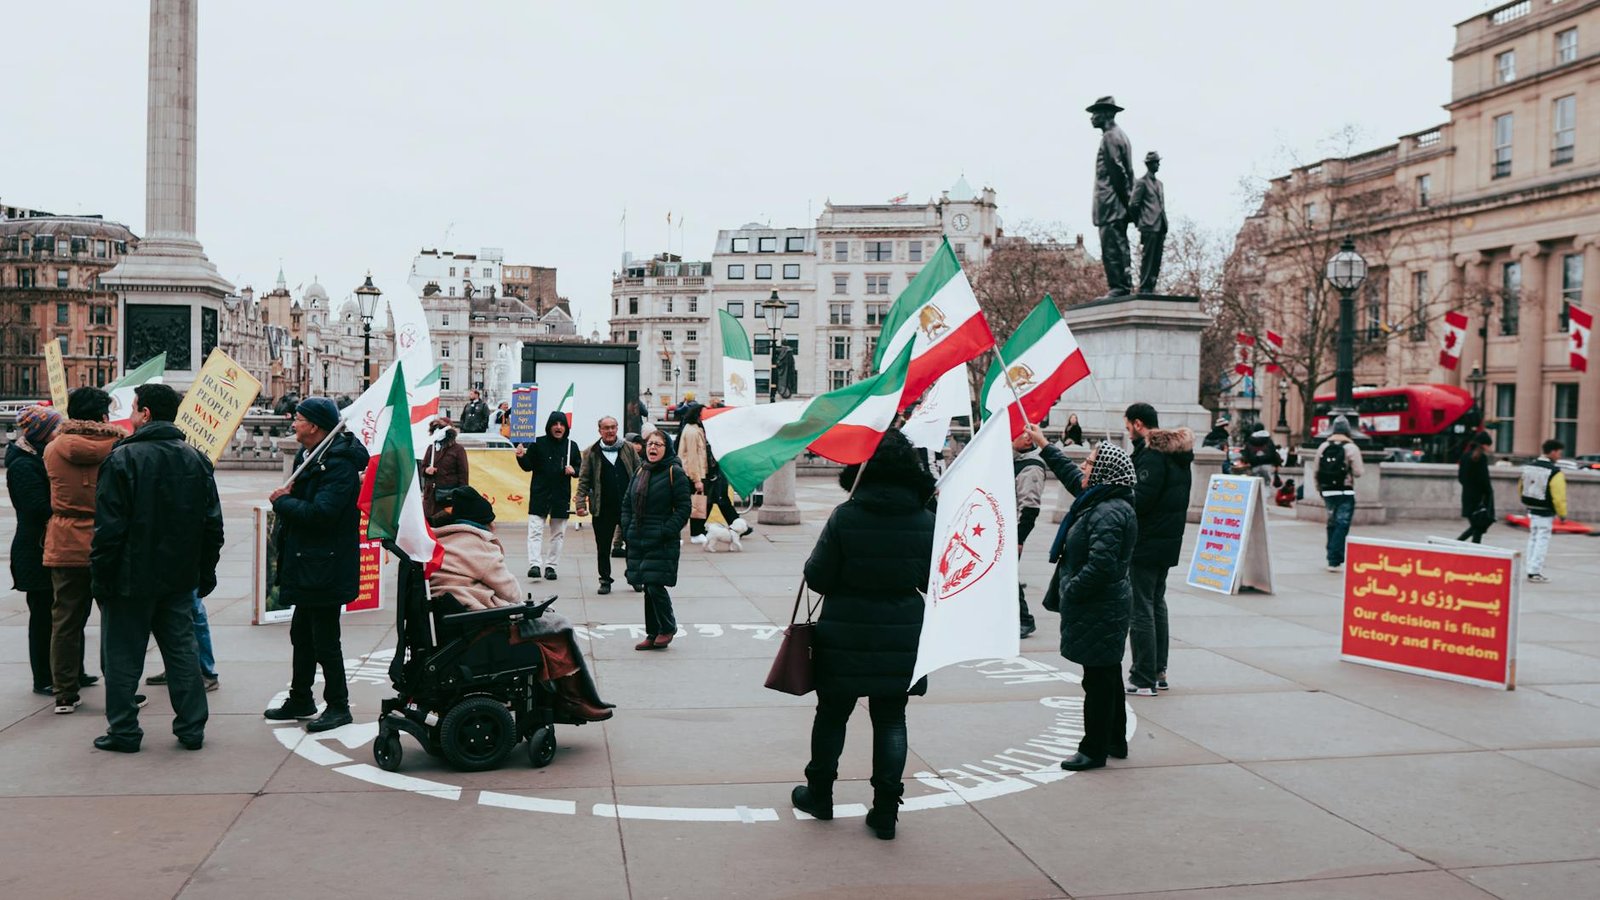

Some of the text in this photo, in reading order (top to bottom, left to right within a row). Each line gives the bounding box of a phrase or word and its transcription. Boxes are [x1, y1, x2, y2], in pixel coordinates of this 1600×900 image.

[196, 388, 232, 421] PEOPLE
[202, 374, 241, 409] IRANIAN
[181, 411, 217, 447] REGIME
[194, 403, 221, 430] WANT
[1215, 530, 1241, 540] terrorist
[1225, 518, 1240, 528] IRGC
[1206, 541, 1223, 551] group
[1416, 560, 1441, 578] ما
[1444, 568, 1503, 586] تصمیم
[1409, 590, 1418, 604] و
[1421, 590, 1500, 616] پیروزی
[1353, 606, 1496, 638] Our decision is final
[1349, 625, 1499, 661] Victory and Freedom
